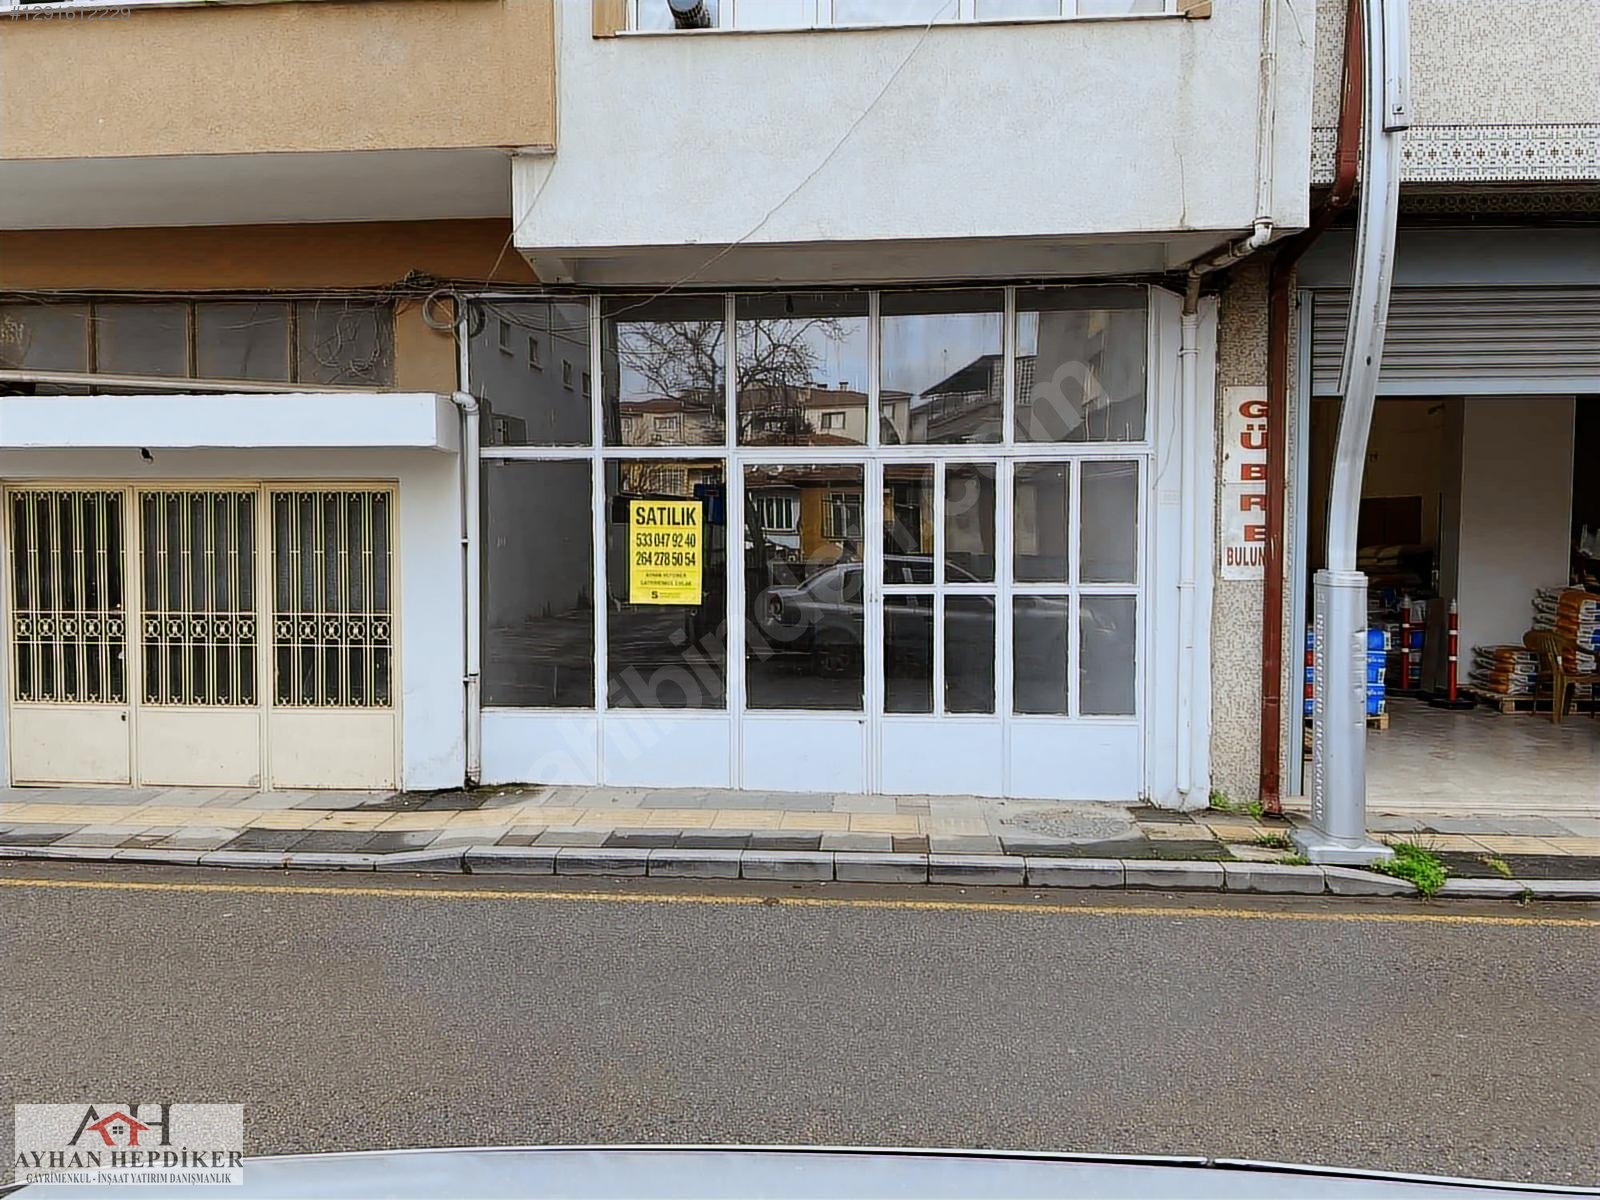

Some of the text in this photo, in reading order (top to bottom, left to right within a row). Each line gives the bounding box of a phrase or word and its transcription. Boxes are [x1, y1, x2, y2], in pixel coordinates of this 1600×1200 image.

[636, 506, 696, 526] SATILIK
[636, 533, 696, 548] 533 047 92 40
[636, 551, 696, 566] 264 278 50 54
